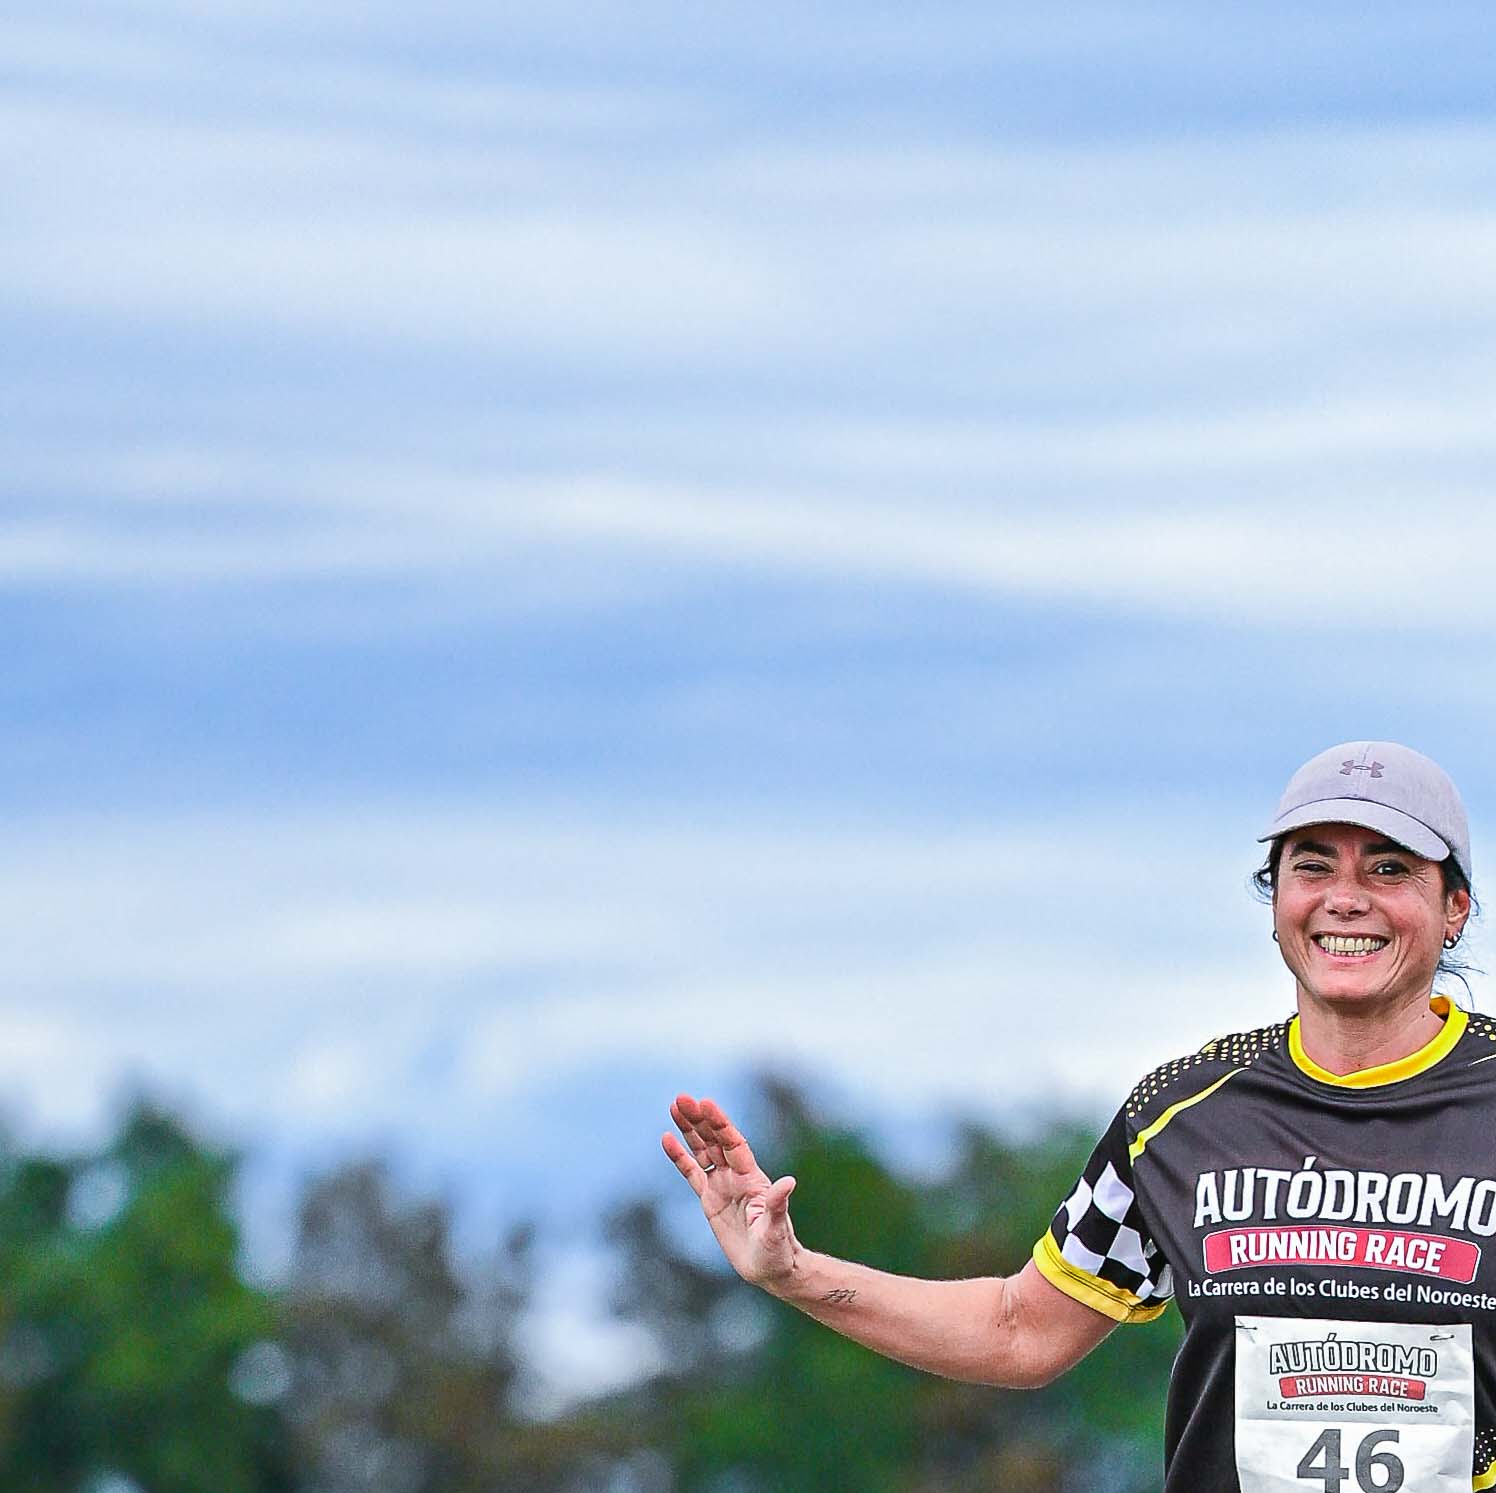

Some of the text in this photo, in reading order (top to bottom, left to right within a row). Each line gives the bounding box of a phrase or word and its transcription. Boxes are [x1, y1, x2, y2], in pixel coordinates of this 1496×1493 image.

[1229, 1230, 1446, 1273] RUNNING RACE
[1188, 1277, 1496, 1310] La Carrera de los Clubes del Noroeste
[1270, 1333, 1437, 1377] AUTÓDROMO
[1295, 1377, 1409, 1397] RUNNING RACE
[1267, 1401, 1438, 1413] La Carrera de los Clubes del Noroeste
